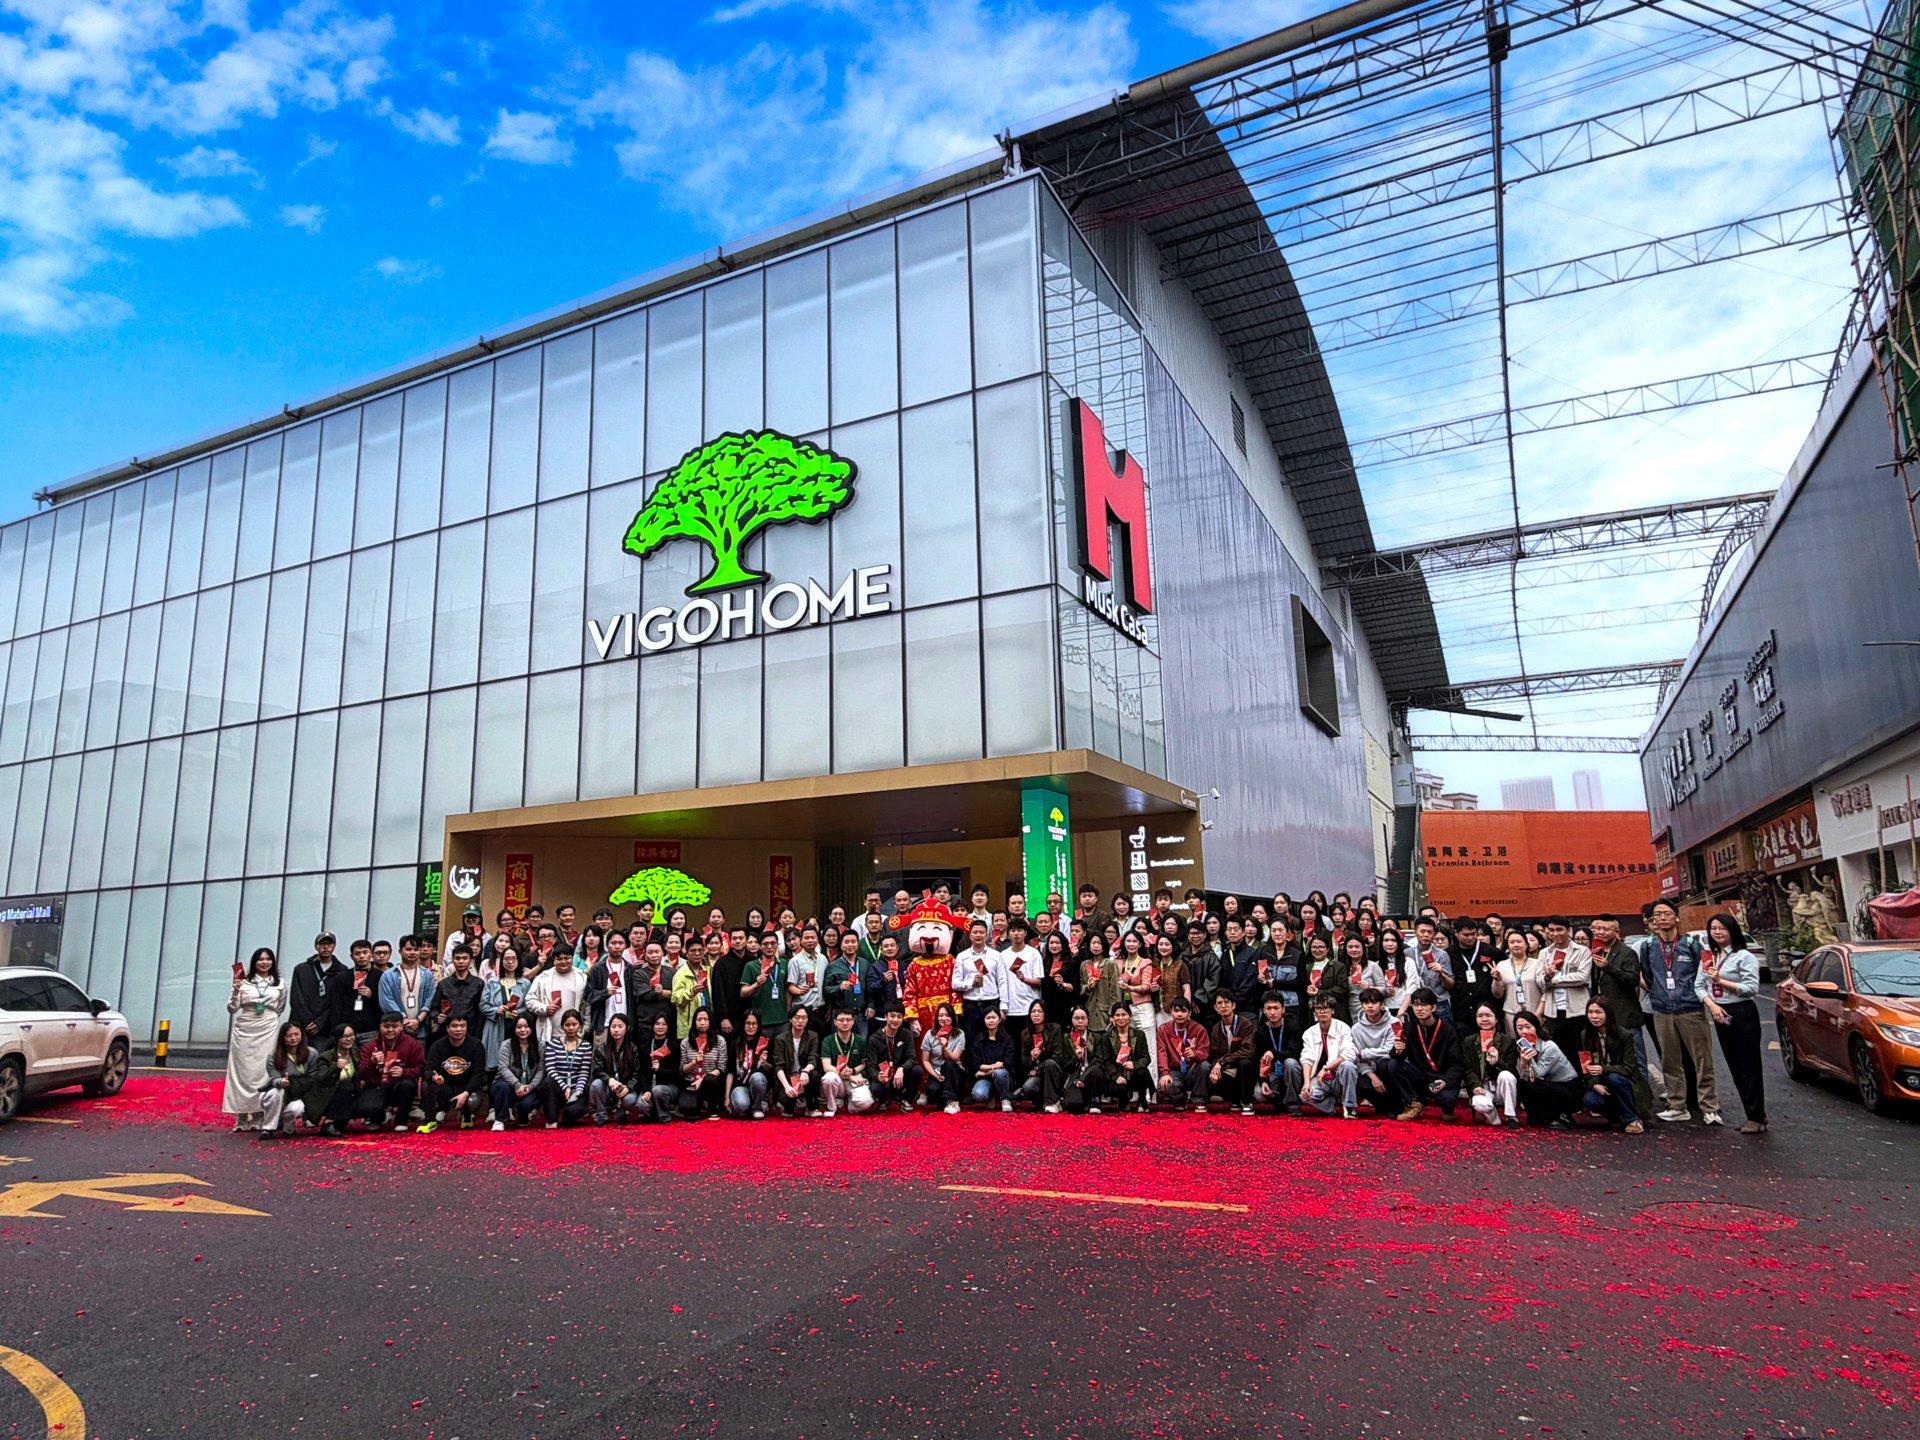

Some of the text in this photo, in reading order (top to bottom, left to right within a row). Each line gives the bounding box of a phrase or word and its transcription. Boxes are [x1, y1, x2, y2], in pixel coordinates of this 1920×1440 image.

[587, 564, 891, 660] VIGOHOME
[1085, 575, 1149, 646] Musk Casa
[425, 864, 442, 894] 招
[7, 906, 35, 920] Material
[35, 905, 51, 918] Mall
